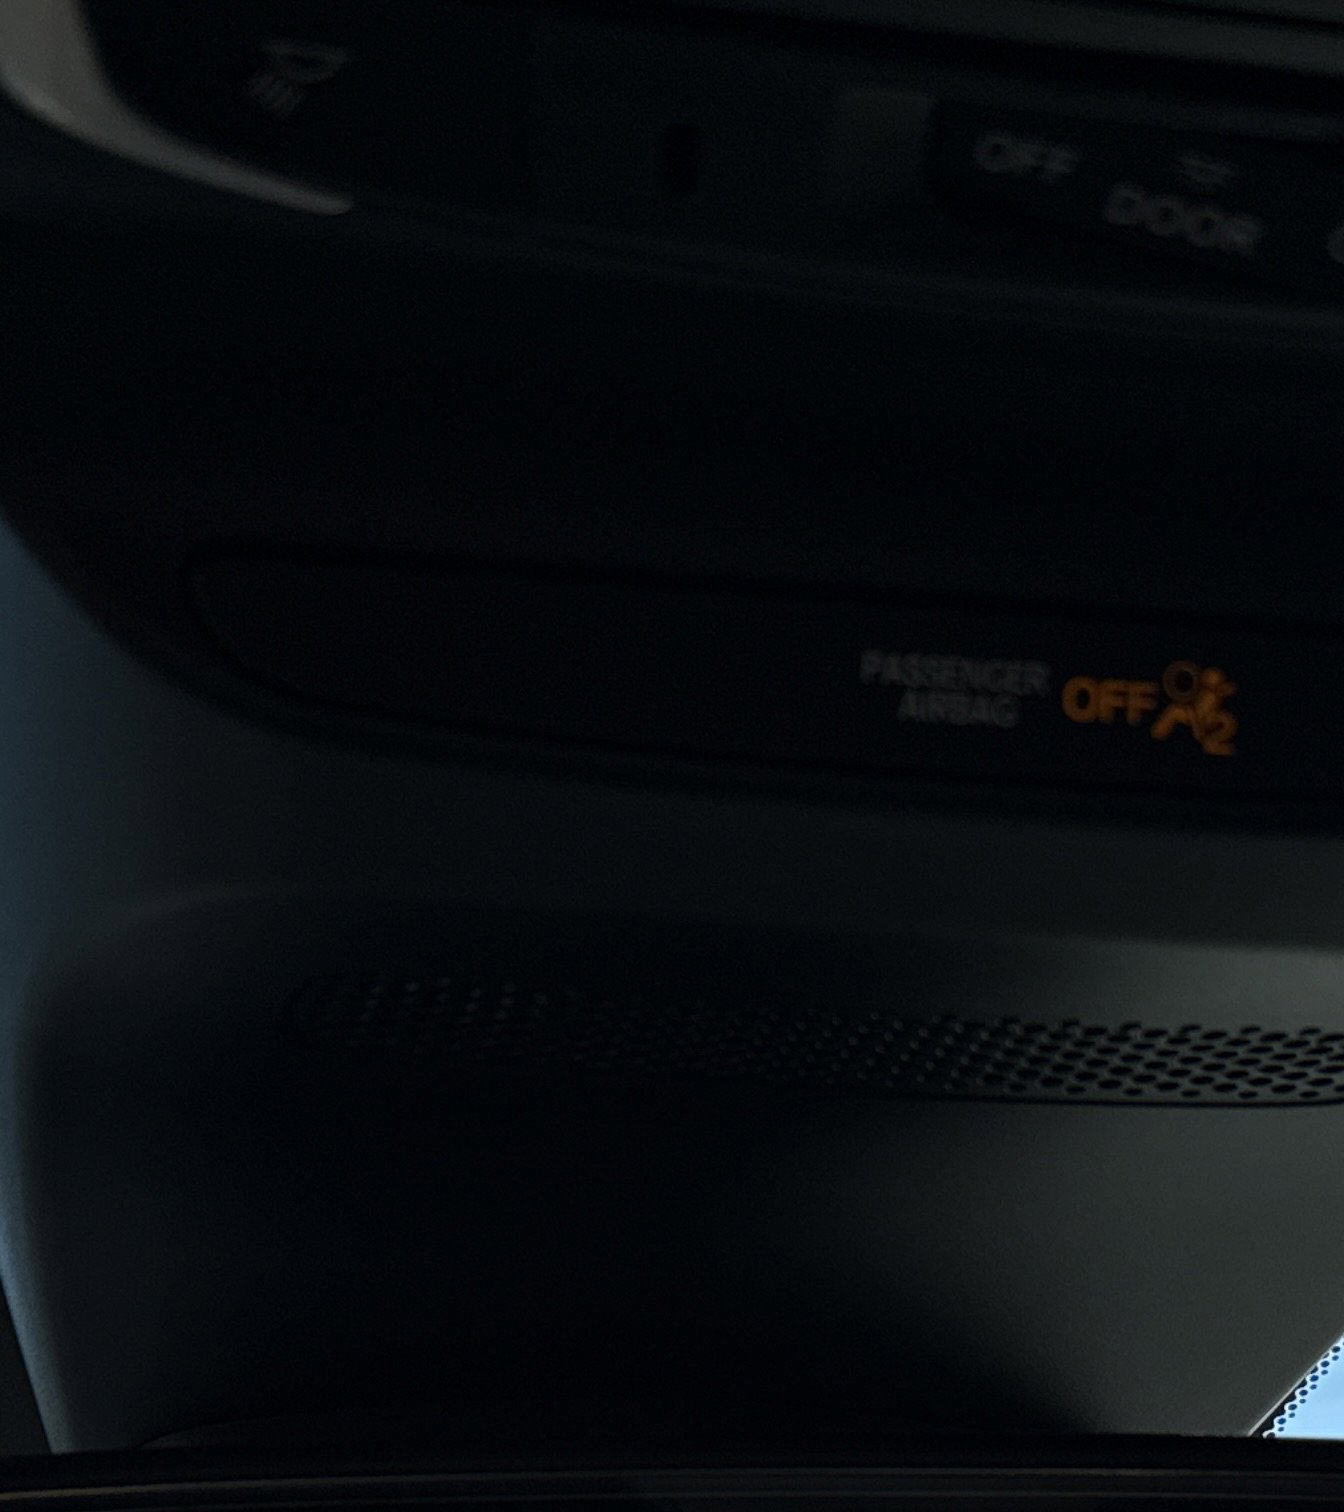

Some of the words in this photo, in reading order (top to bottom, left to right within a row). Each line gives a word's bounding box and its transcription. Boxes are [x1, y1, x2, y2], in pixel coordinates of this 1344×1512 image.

[974, 130, 1078, 182] OFF
[1105, 183, 1264, 254] DOOR
[861, 650, 1050, 696] PASSENGER
[897, 690, 1019, 726] AIRBAG
[1061, 675, 1159, 724] OFF
